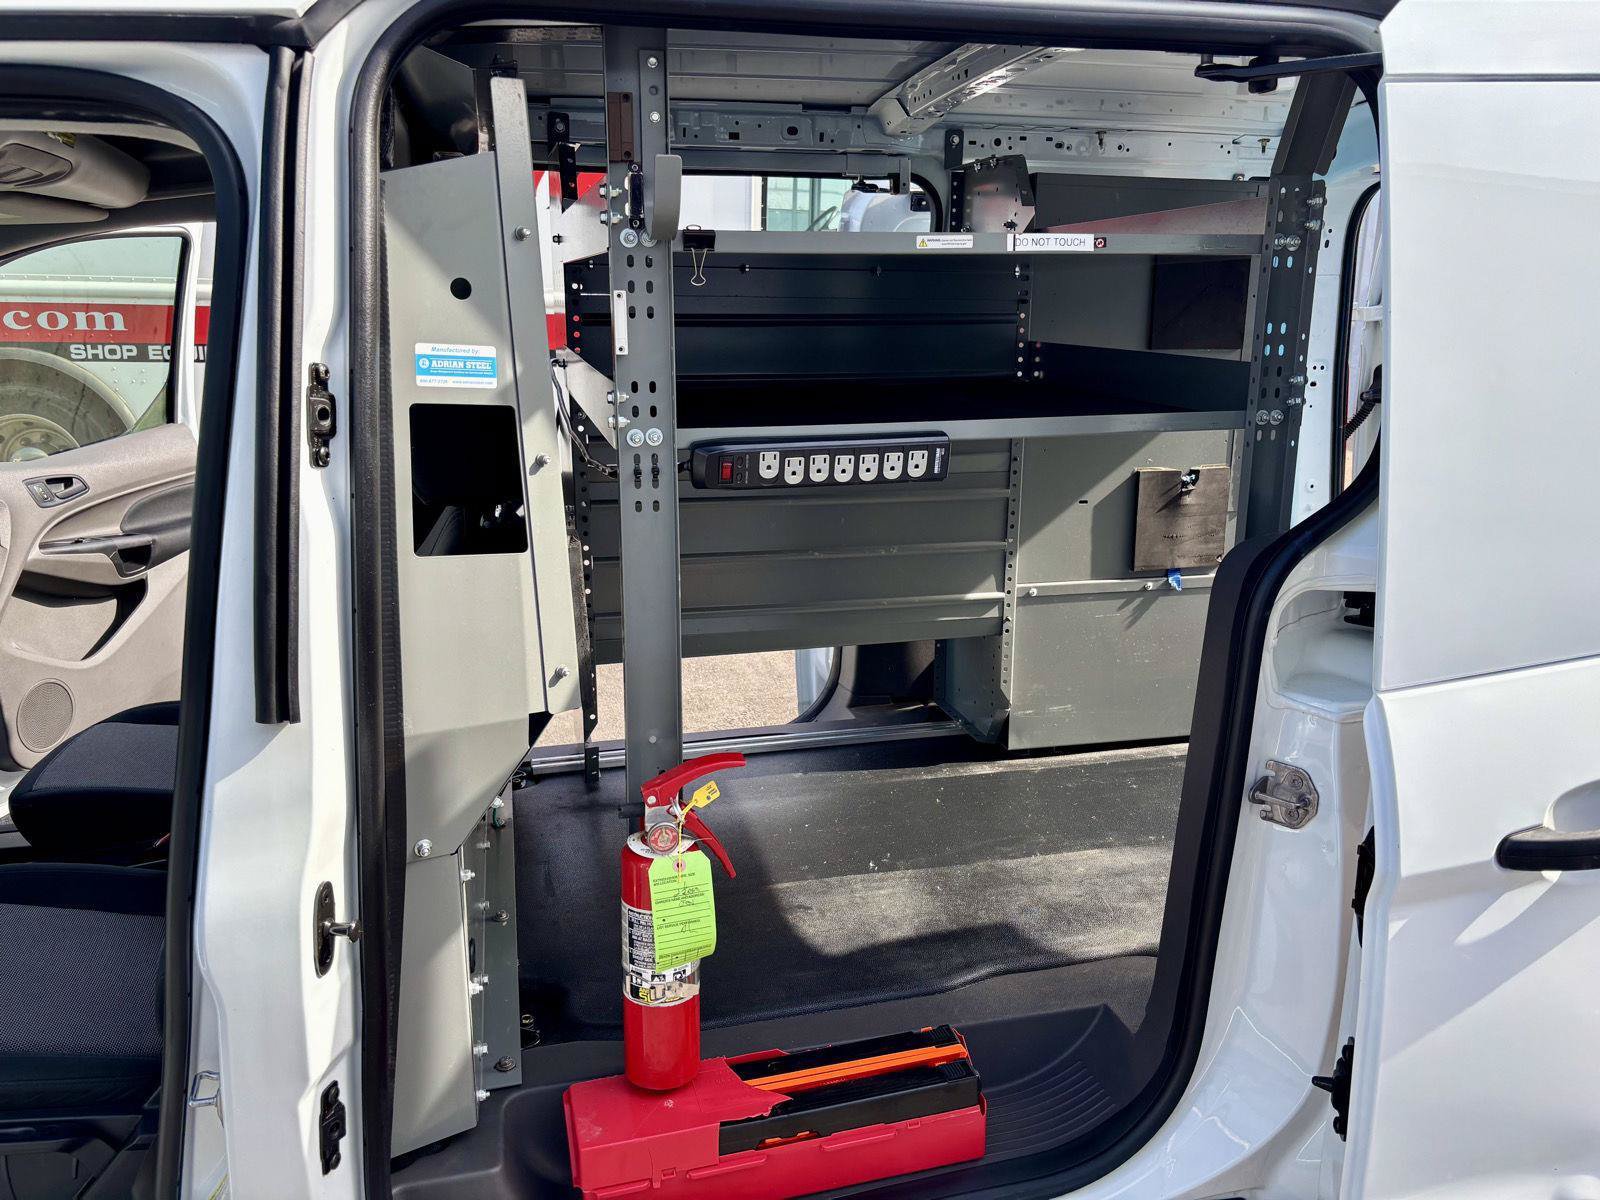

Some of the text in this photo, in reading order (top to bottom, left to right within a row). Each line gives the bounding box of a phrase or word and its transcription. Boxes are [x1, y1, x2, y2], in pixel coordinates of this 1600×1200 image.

[1015, 236, 1086, 247] DO NOT TOUCH
[2, 310, 129, 331] com
[69, 344, 138, 360] SHOP
[431, 345, 471, 354] Manufactured
[431, 360, 492, 370] ADRIAN STEEL
